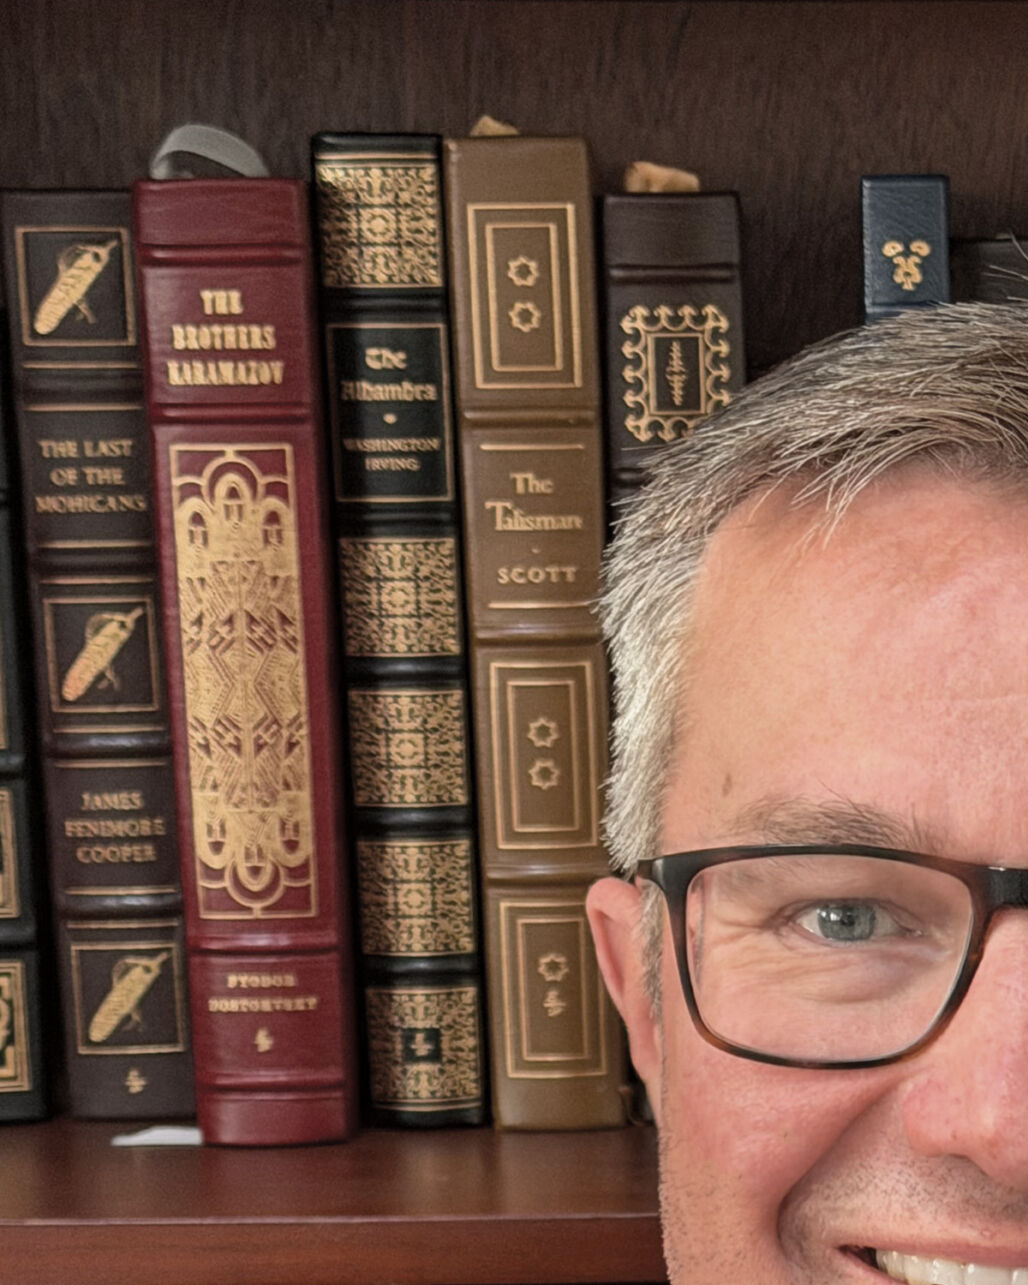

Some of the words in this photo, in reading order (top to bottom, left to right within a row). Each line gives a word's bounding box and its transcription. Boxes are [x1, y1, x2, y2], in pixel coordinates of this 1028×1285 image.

[201, 288, 243, 315] THE
[172, 324, 276, 350] BROTHERS
[365, 347, 407, 370] The
[167, 360, 284, 385] KARAMAZOV
[341, 381, 437, 401] Alhambra
[37, 438, 78, 458] THE
[83, 438, 133, 458] LAST
[364, 457, 421, 471] IRVING
[49, 466, 78, 486] OF
[81, 466, 126, 485] THE
[510, 472, 554, 494] The
[35, 494, 147, 513] MOHICANS
[484, 501, 583, 531] Talisman
[497, 567, 577, 584] SCOTT
[76, 844, 157, 864] COOPER
